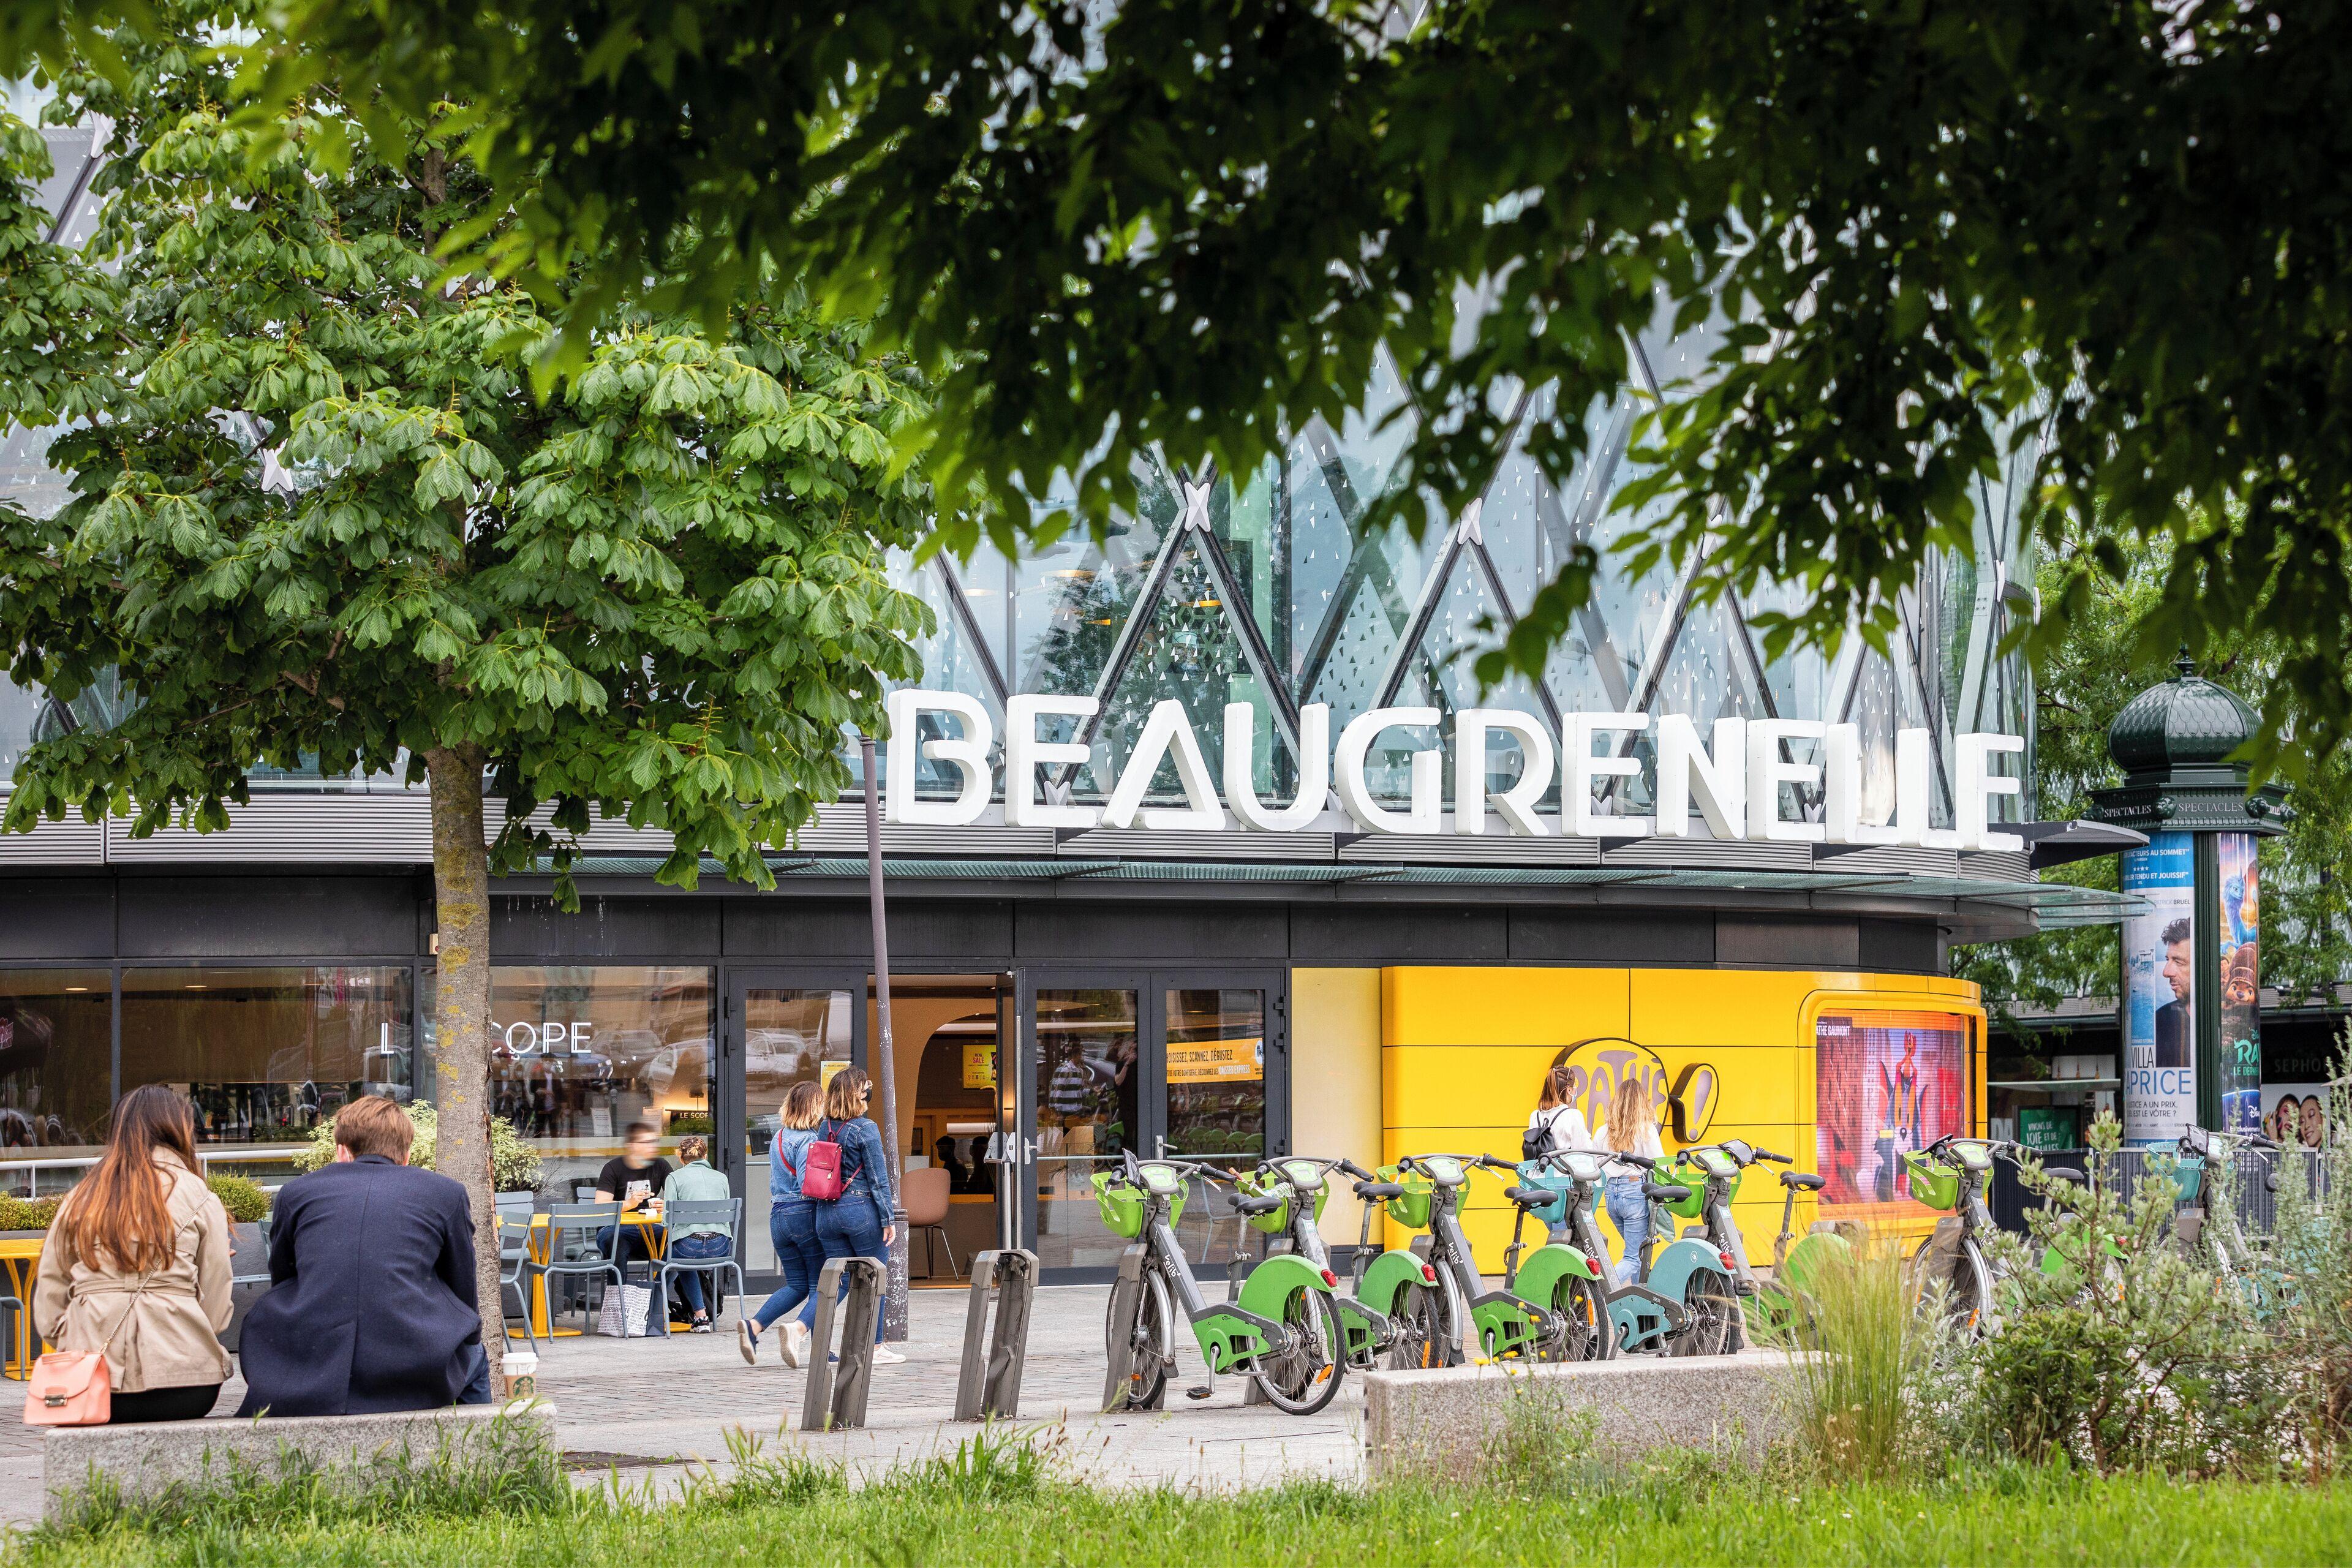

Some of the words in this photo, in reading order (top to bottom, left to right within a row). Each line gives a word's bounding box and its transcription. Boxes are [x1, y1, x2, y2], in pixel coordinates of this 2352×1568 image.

[886, 688, 2025, 852] BEAUGRENELLE
[2103, 805, 2152, 818] SPECTACLES
[2177, 802, 2244, 812] SPECTACLES
[1828, 1025, 1850, 1036] GAUMONT
[1211, 1048, 1233, 1061] DÉGUSTEZ
[2132, 1047, 2154, 1068] VILLA
[1219, 1066, 1234, 1074] CAISSES
[1234, 1065, 1250, 1074] EXPRESS
[2233, 1066, 2241, 1076] LE
[2274, 1058, 2327, 1073] SEPHO
[2149, 1109, 2171, 1117] VÔTRE
[2026, 1131, 2042, 1145] JOIE
